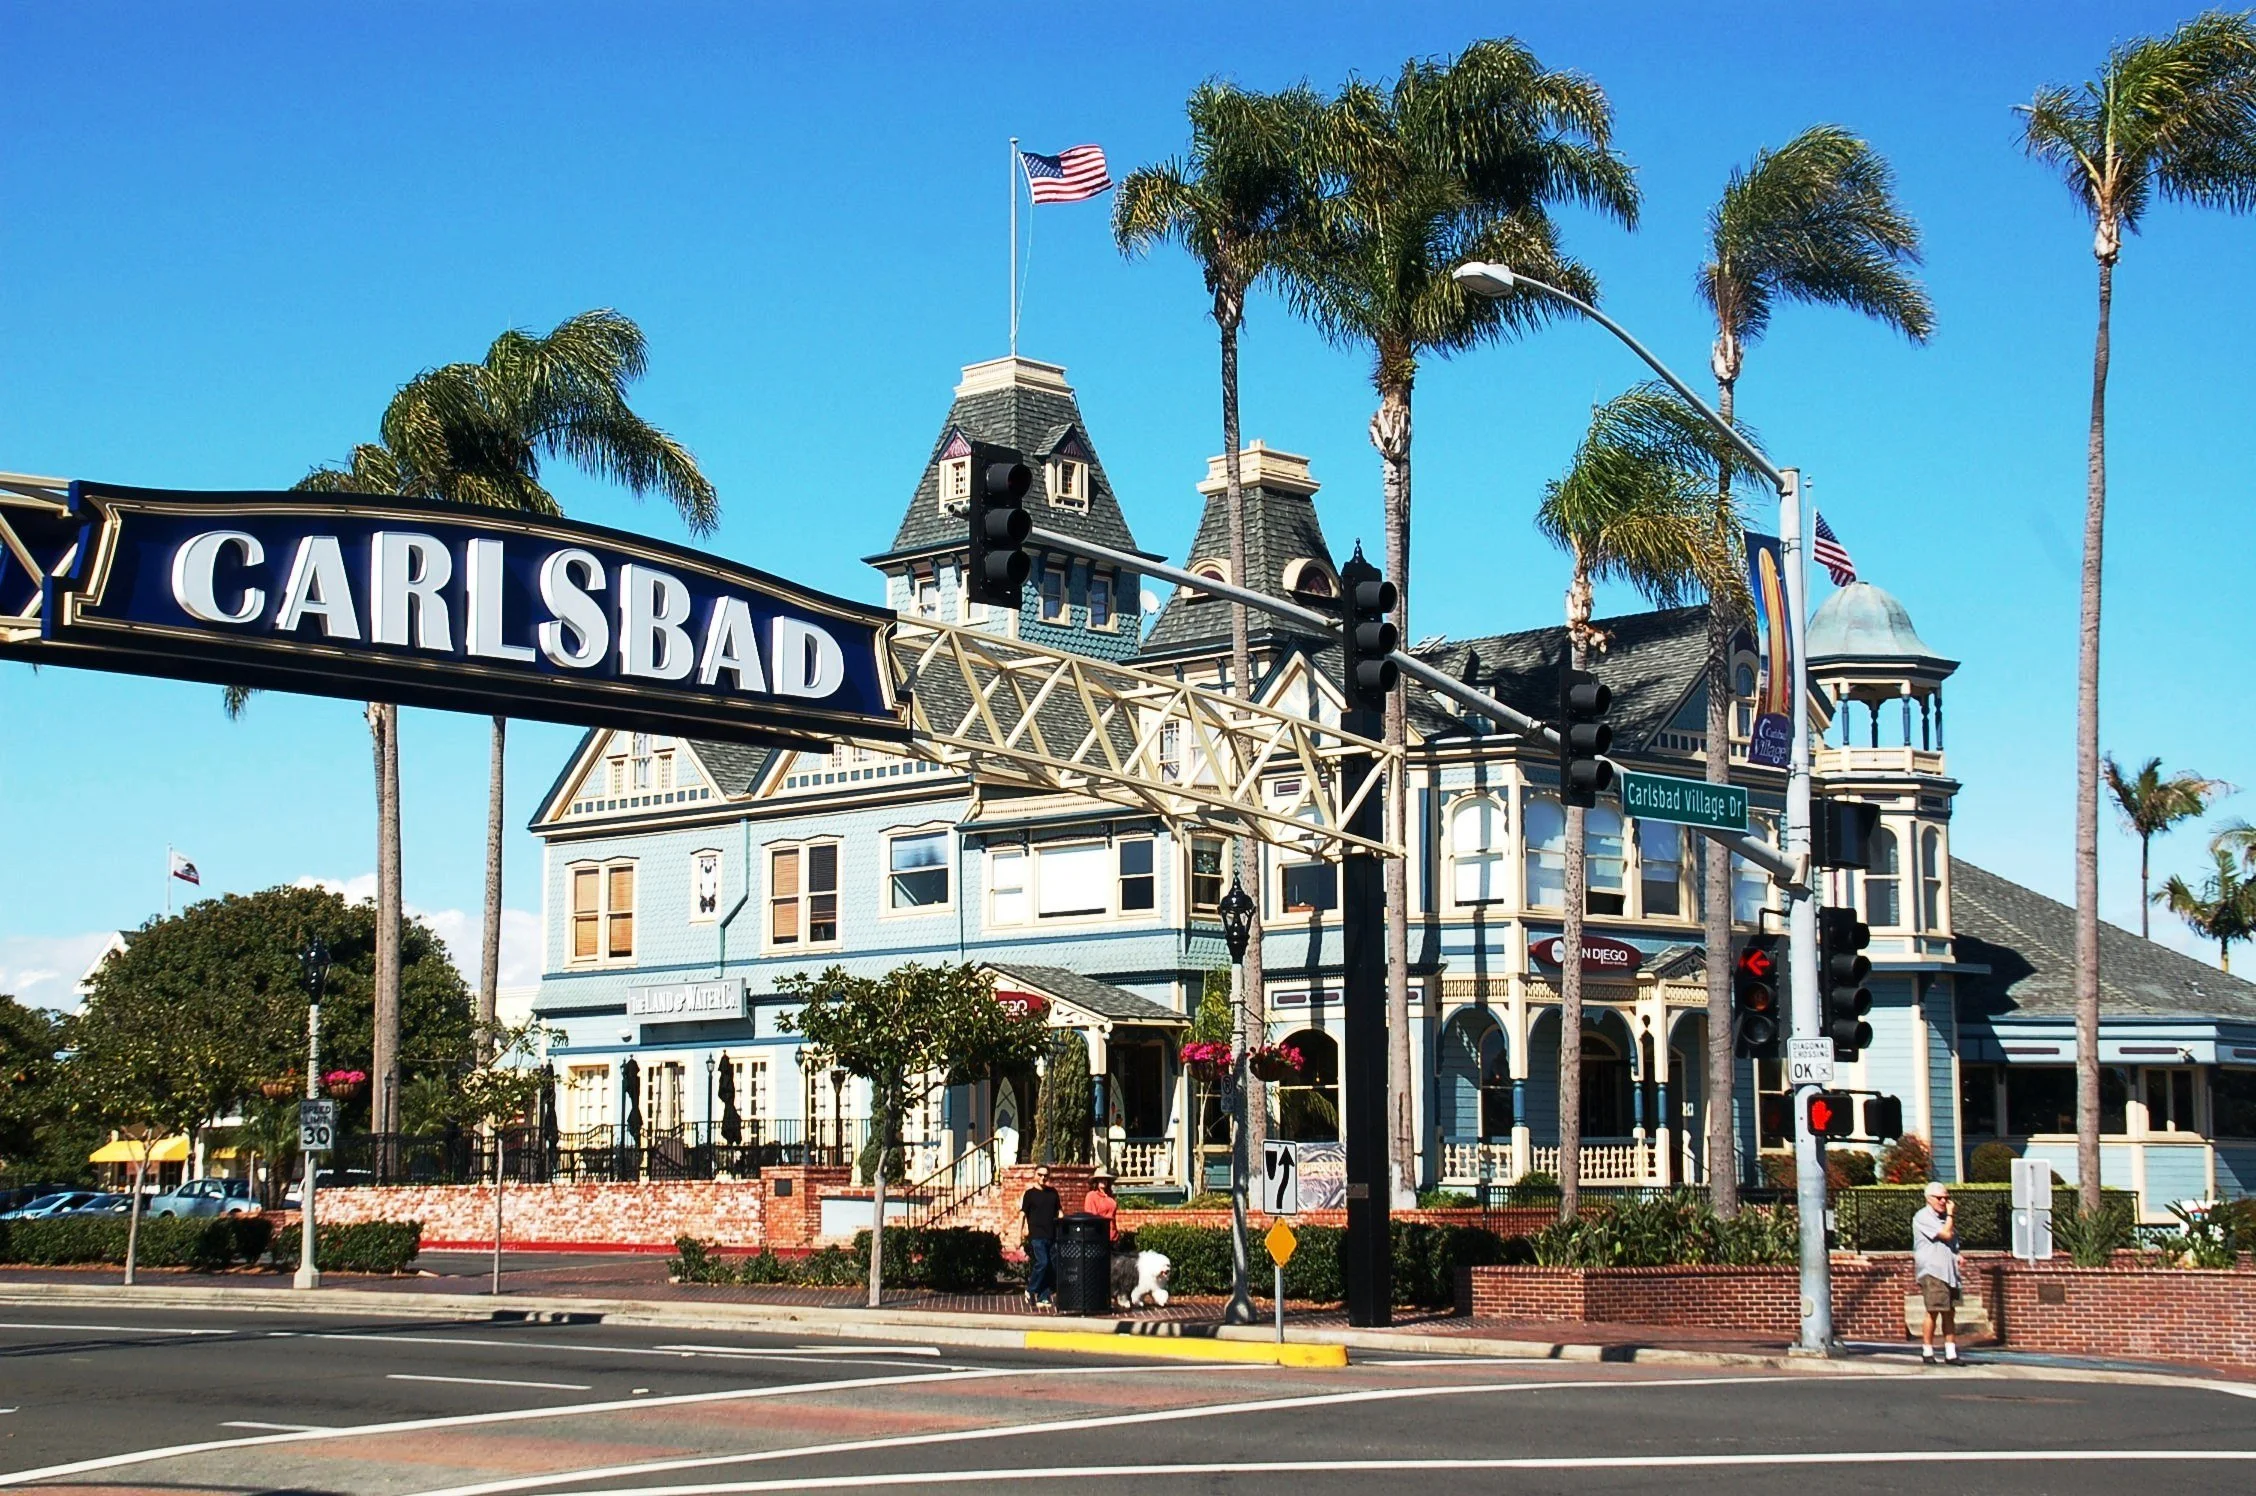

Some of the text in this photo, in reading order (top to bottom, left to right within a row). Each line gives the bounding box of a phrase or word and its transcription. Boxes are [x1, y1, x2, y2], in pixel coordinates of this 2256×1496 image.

[171, 529, 845, 699] CARLSBAD
[1754, 738, 1786, 764] Village
[1628, 782, 1742, 821] Carlsbad Village Dr
[1592, 948, 1628, 965] DIEGO
[645, 987, 673, 1014] LAND
[684, 984, 721, 1011] WATER
[1792, 1042, 1829, 1050] DIAGONAL
[1793, 1050, 1830, 1059] CROSSING
[1794, 1063, 1813, 1079] OK
[302, 1105, 331, 1115] SPEED
[302, 1115, 329, 1125] LIMIT
[302, 1126, 330, 1145] 30
